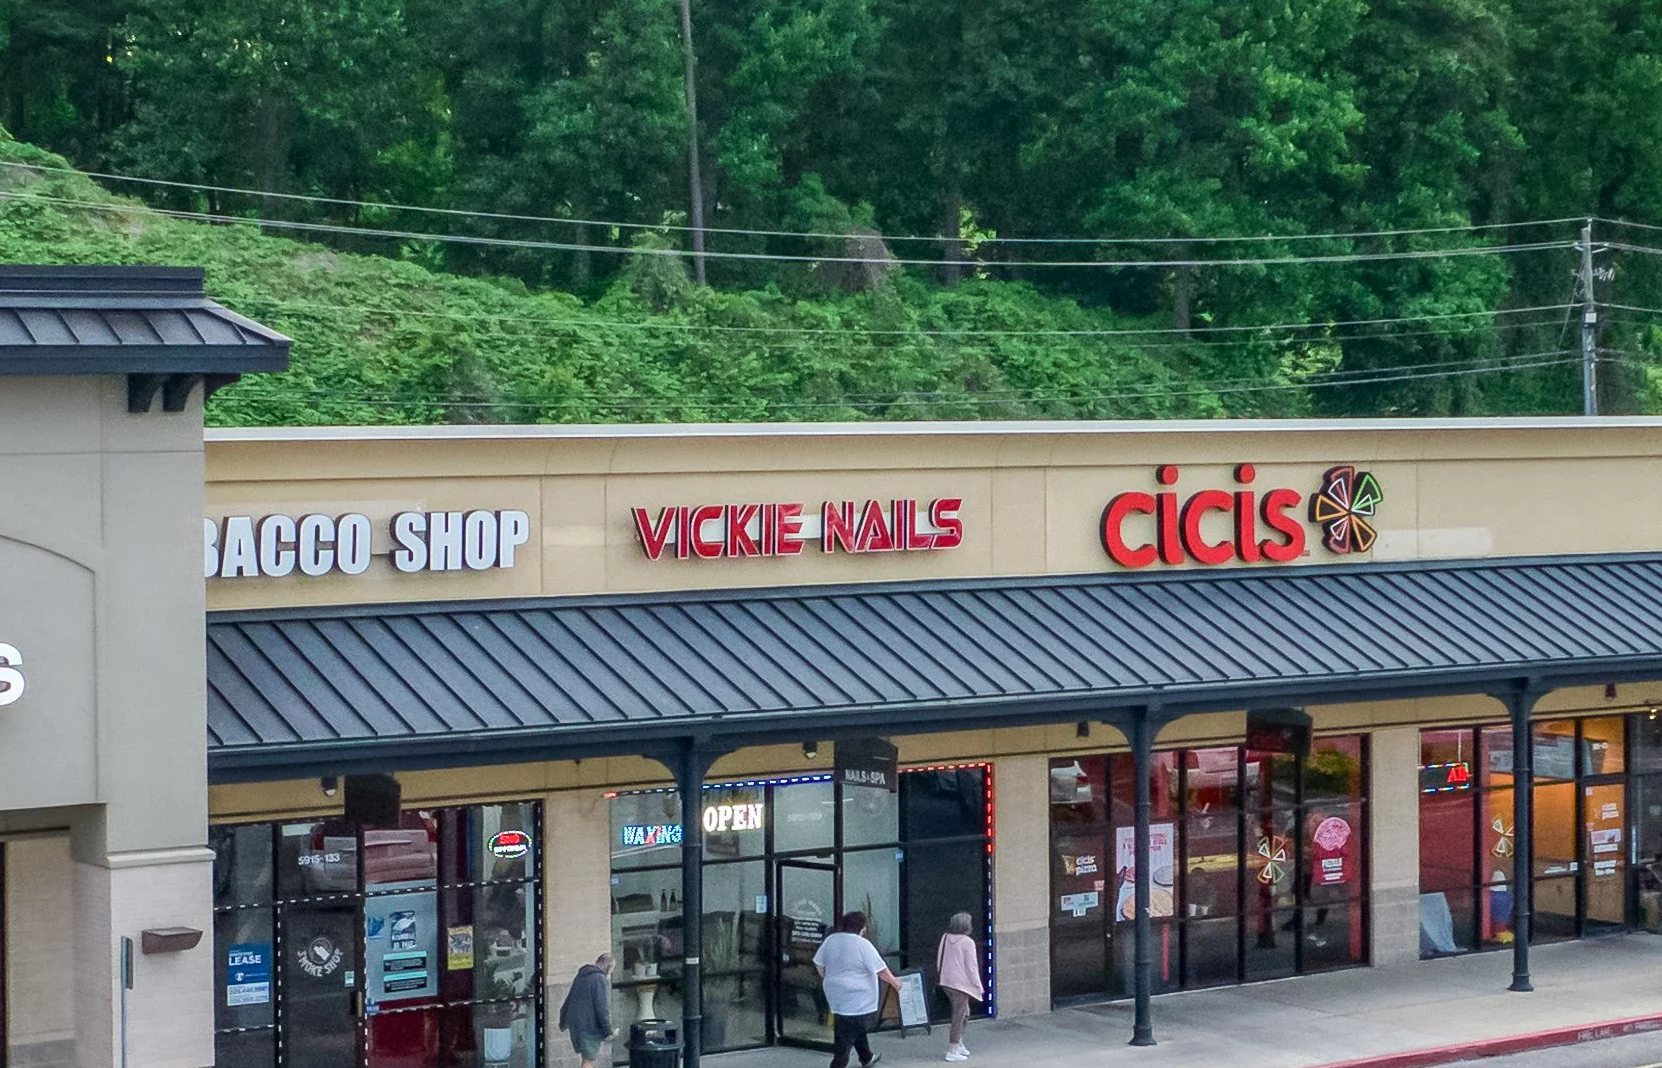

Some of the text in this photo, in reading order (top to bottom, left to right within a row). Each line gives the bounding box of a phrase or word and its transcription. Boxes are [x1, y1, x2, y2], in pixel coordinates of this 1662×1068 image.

[632, 498, 964, 561] VICKIE NAILS
[1099, 463, 1306, 568] cicis
[389, 510, 531, 572] SHOP
[702, 803, 764, 832] OPEN
[622, 824, 683, 845] WAXING
[228, 954, 262, 967] LEASE
[297, 950, 323, 977] SMOKE
